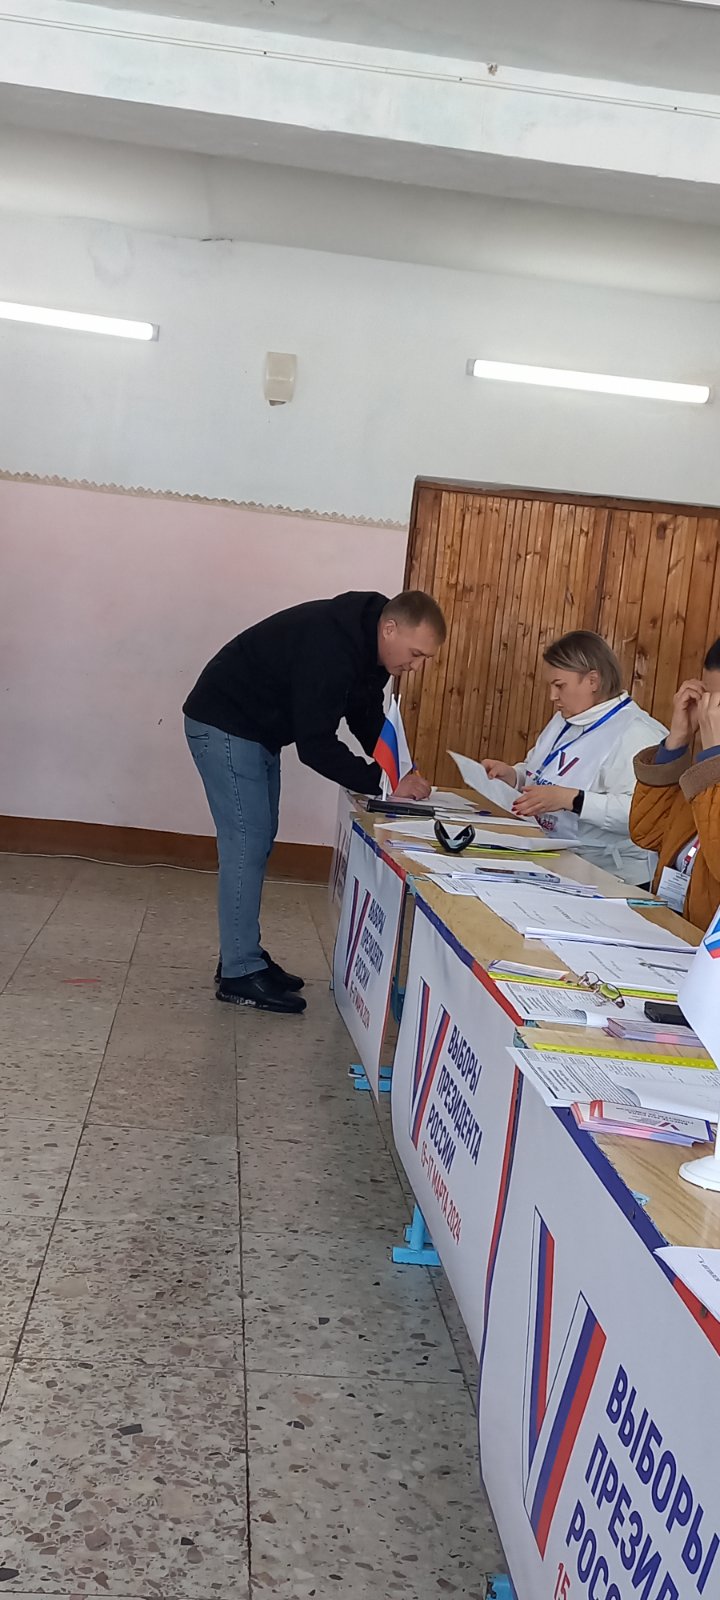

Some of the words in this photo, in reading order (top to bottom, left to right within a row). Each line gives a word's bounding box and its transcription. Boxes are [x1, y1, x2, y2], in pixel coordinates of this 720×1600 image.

[447, 1025, 482, 1096] ВЫБОРЫ
[426, 1103, 457, 1175] РОССИИ
[435, 1064, 483, 1165] ПРЕЗИДЕНТА
[431, 1164, 449, 1218] МАРТА
[447, 1199, 462, 1246] 2024
[606, 1363, 720, 1595] ВЫБОРЫ
